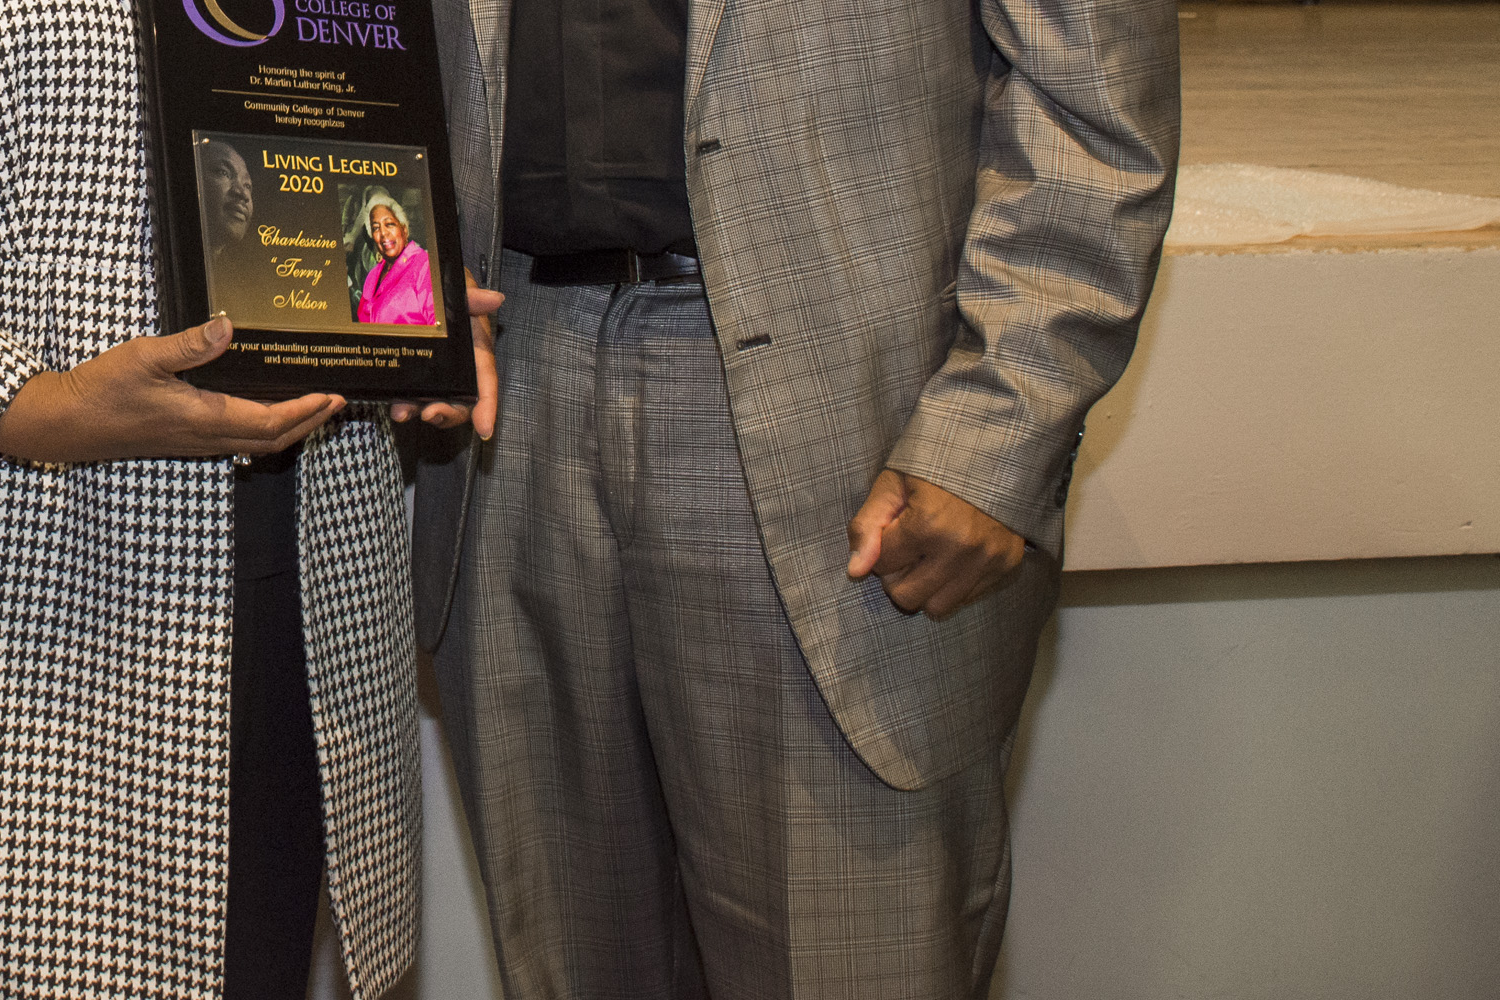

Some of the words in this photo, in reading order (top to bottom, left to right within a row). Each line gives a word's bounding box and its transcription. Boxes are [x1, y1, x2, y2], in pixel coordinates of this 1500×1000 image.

[375, 4, 396, 21] OF
[295, 16, 407, 51] DENVER
[258, 65, 298, 78] Honoring
[299, 68, 313, 78] the
[315, 70, 335, 80] spirit
[337, 72, 346, 80] of
[250, 75, 263, 85] Dr.
[264, 77, 291, 88] Martin
[293, 79, 320, 90] Luther
[322, 81, 344, 93] King,
[346, 84, 357, 93] Jr.
[244, 100, 290, 114] Community
[292, 104, 323, 116] College
[326, 107, 335, 115] of
[337, 108, 366, 118] Denver
[275, 114, 302, 127] hereby
[303, 117, 345, 129] recognizes
[279, 173, 324, 194] 2020
[257, 224, 337, 250] Charleszine
[273, 289, 328, 311] Nelson
[227, 341, 239, 351] or
[240, 342, 260, 353] your
[261, 342, 308, 354] undaunting
[310, 344, 362, 355] commitment
[362, 346, 371, 355] to
[372, 346, 400, 357] paving
[401, 347, 415, 356] the
[416, 348, 433, 358] way
[264, 354, 281, 364] and
[282, 355, 319, 367] enabling
[320, 356, 374, 368] opportunities
[374, 358, 387, 367] for
[388, 358, 401, 368] all.
